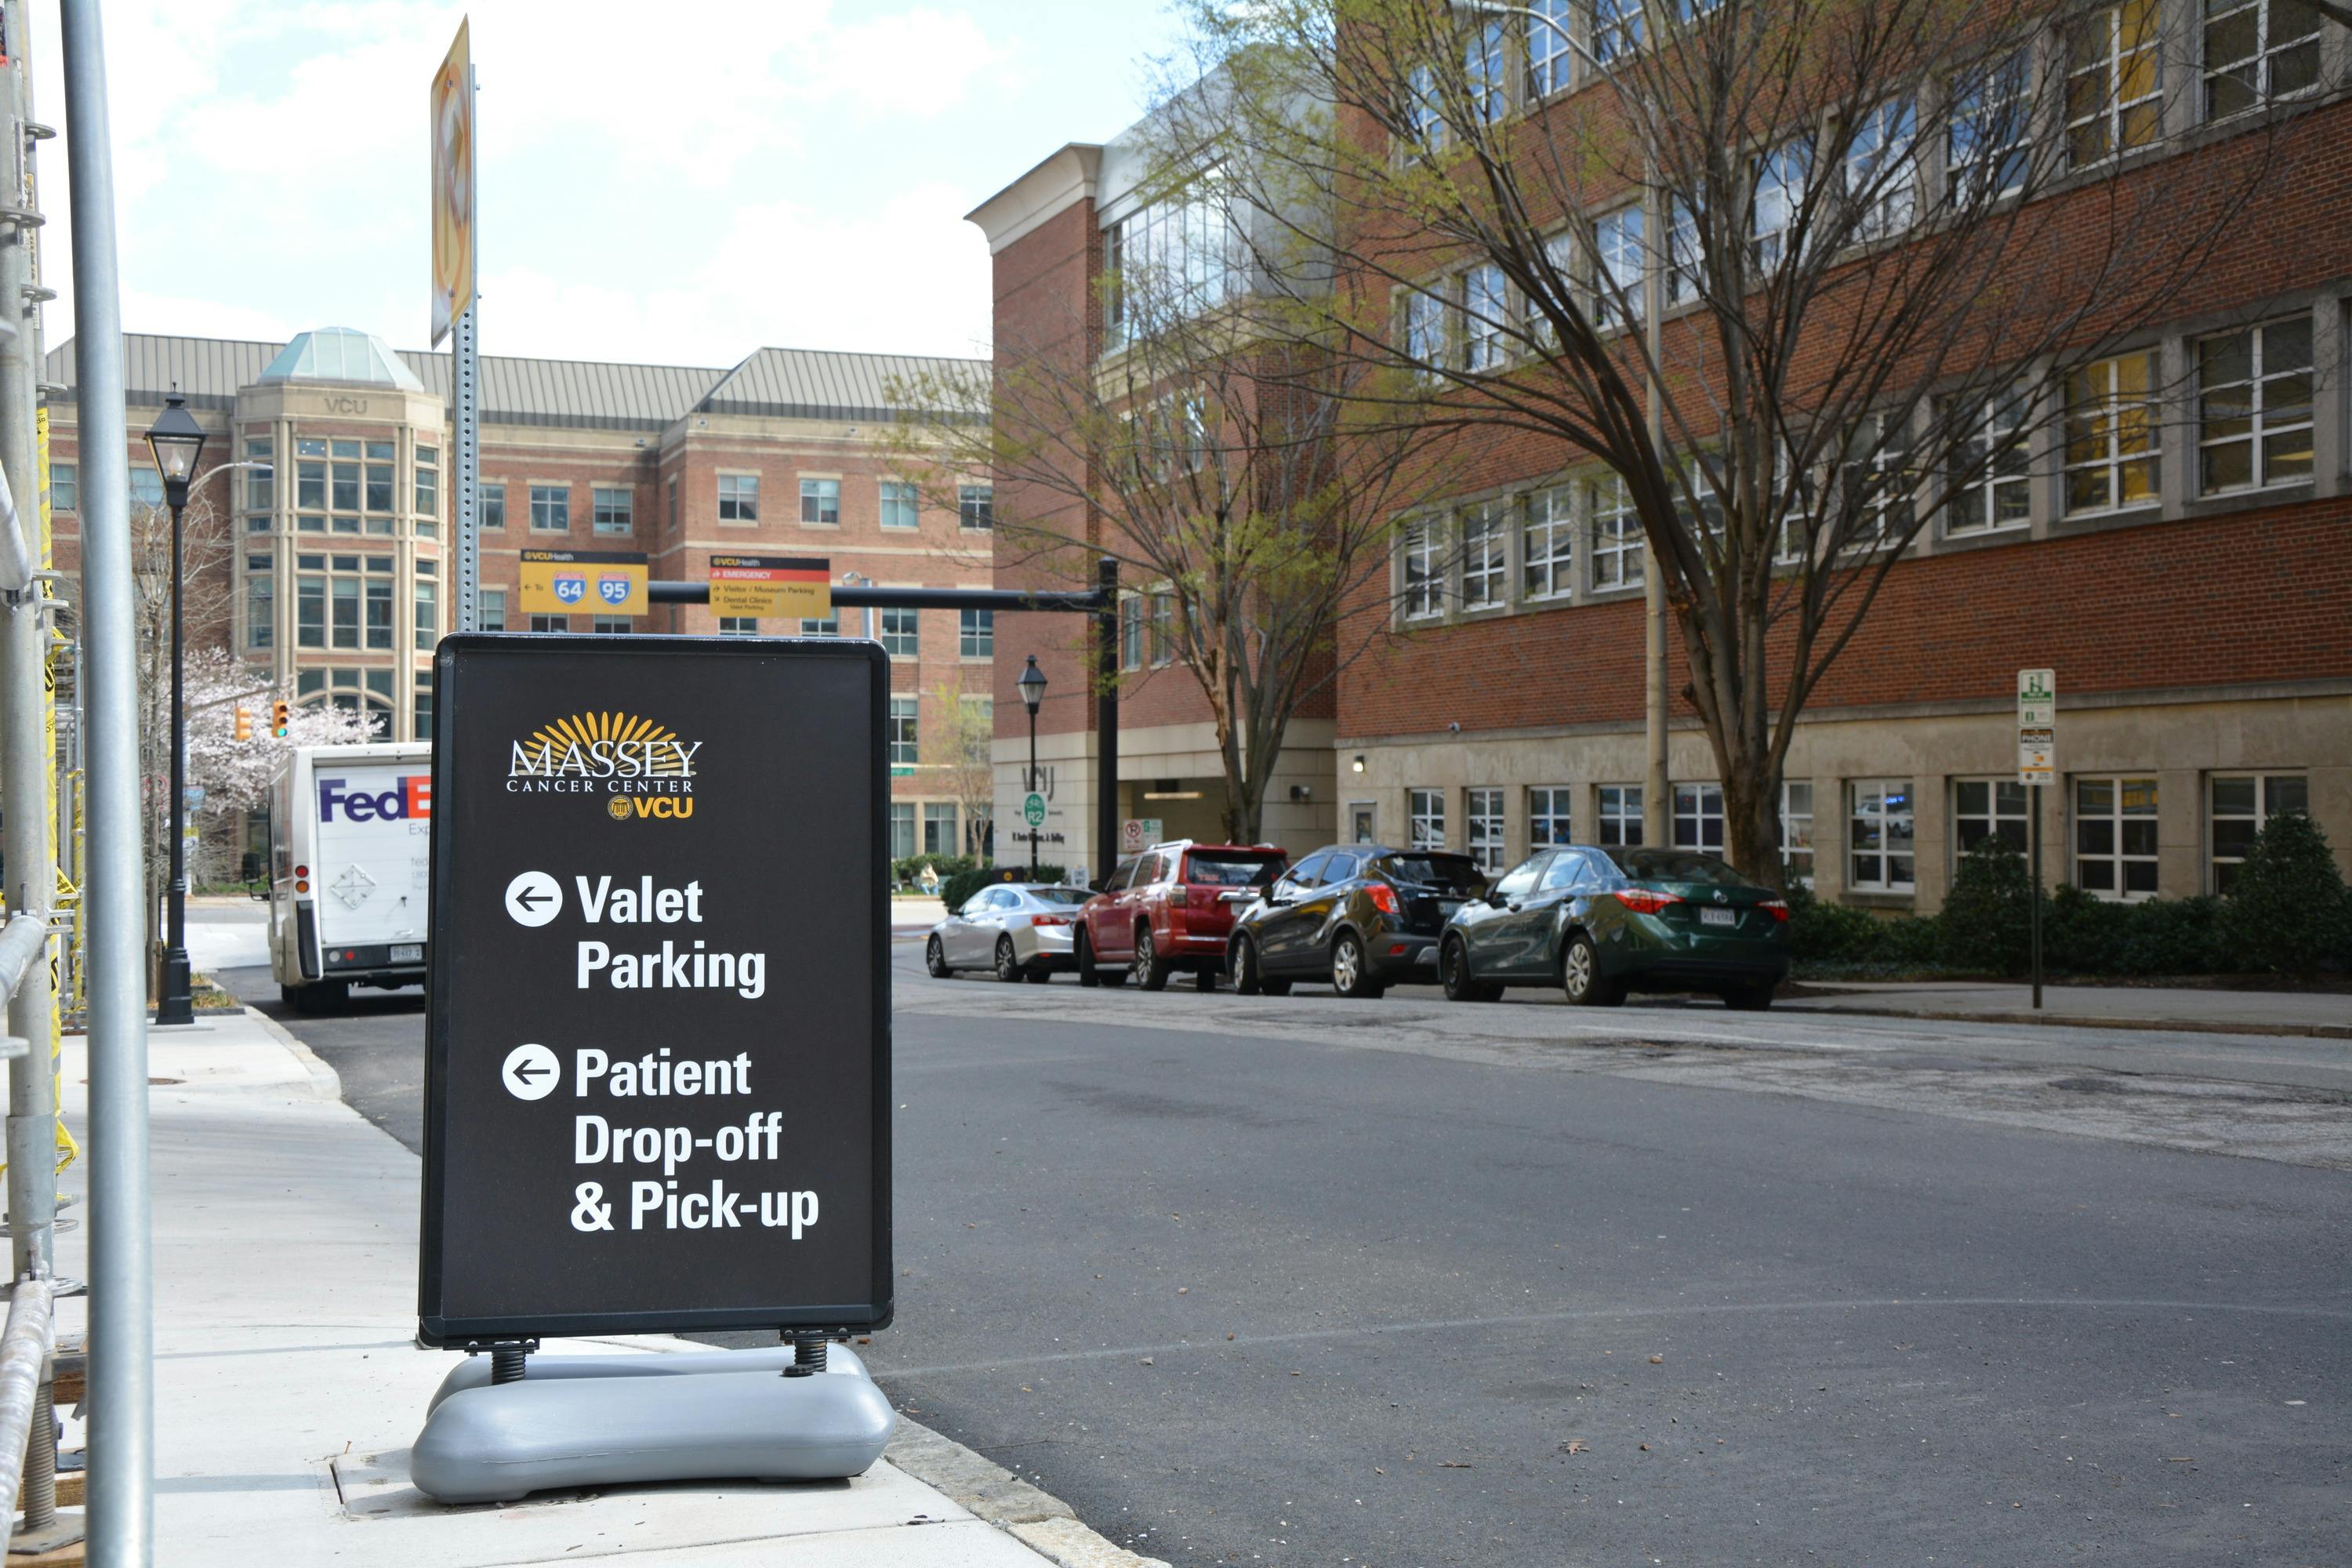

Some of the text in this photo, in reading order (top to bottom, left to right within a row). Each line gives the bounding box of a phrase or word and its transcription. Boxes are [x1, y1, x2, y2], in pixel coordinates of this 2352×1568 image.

[324, 397, 368, 414] VCU
[723, 570, 771, 579] EMERGENCY
[557, 582, 582, 598] 64
[602, 583, 626, 599] 95
[788, 586, 815, 595] Parking
[508, 739, 702, 778] MASSEY
[506, 780, 693, 793] CANCER CENTER
[319, 775, 430, 822] FedE
[633, 797, 693, 818] VCU
[1027, 811, 1044, 822] R2
[575, 875, 703, 924] Valet
[577, 940, 765, 1000] Parking
[575, 1047, 752, 1097] Patient
[575, 1111, 782, 1176] Drop-off
[570, 1179, 819, 1240] & Pick-up
